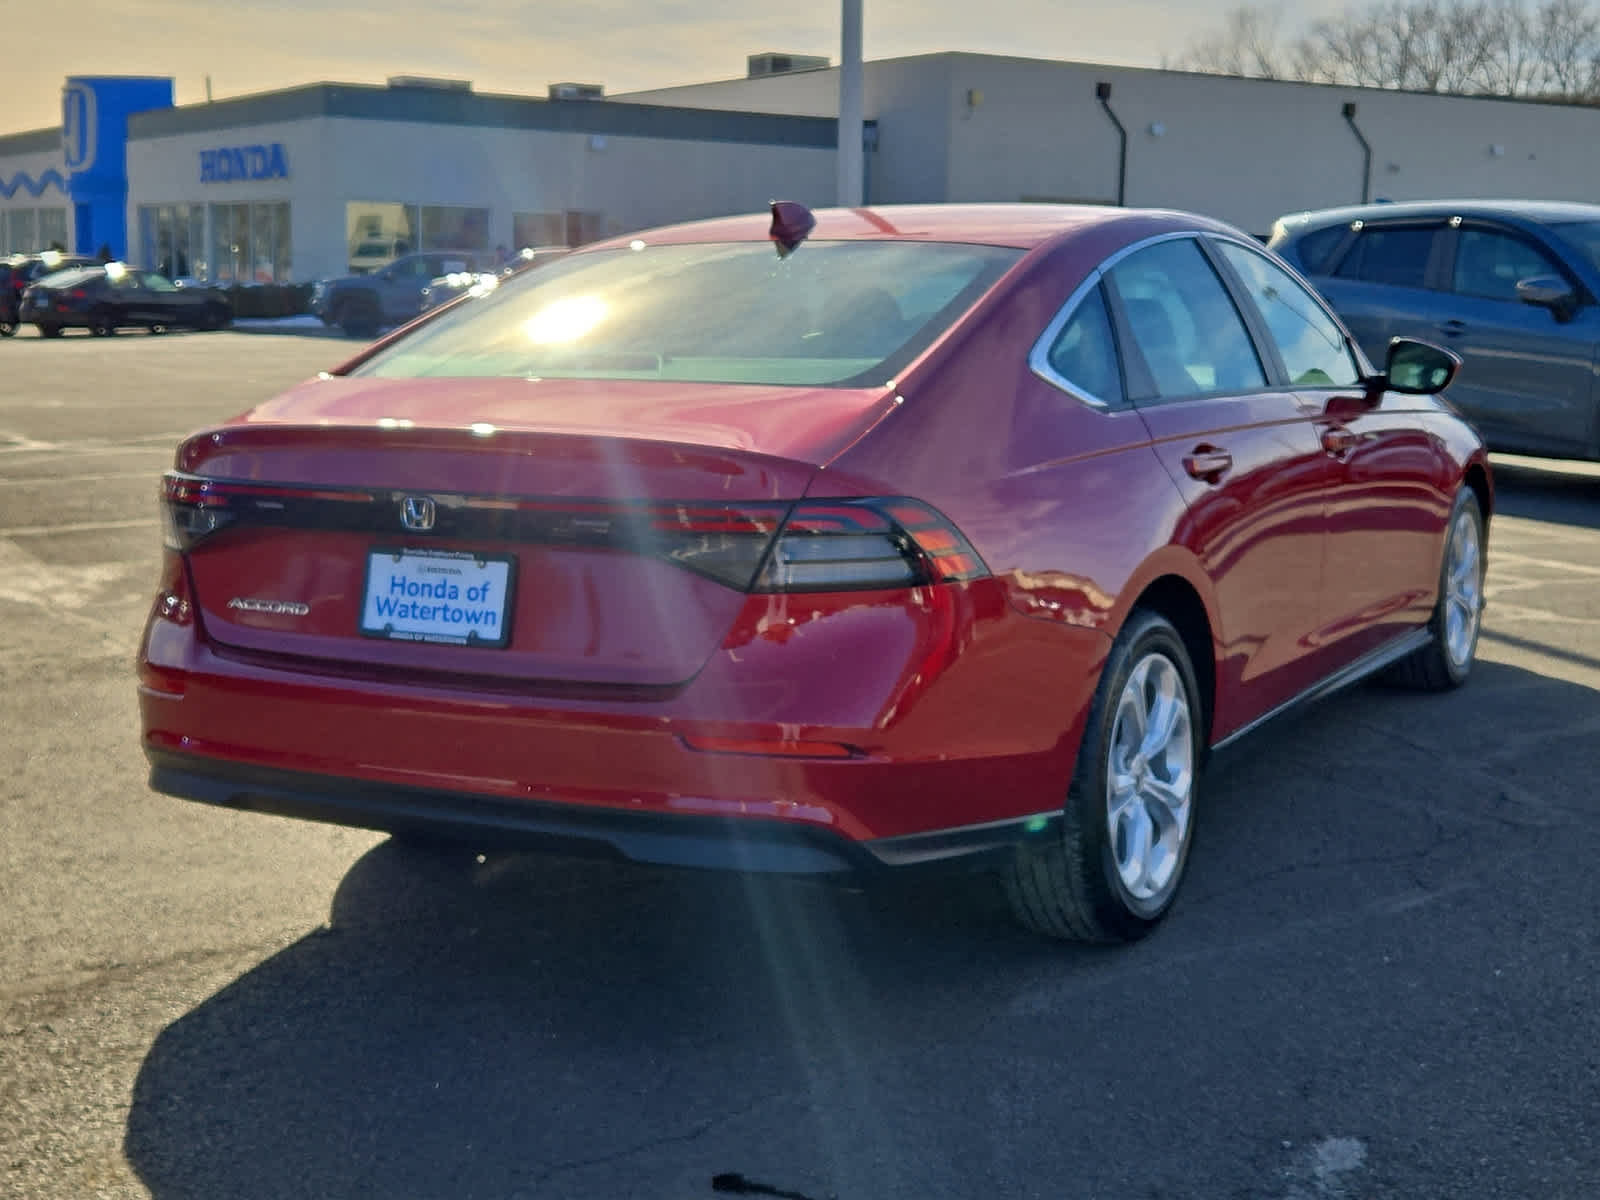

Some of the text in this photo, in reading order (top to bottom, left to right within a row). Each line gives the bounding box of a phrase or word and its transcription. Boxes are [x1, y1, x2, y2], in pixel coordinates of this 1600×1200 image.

[199, 144, 288, 182] HONDA
[390, 575, 491, 602] Honda of
[227, 598, 309, 616] ACCORD
[376, 595, 497, 626] Watertown
